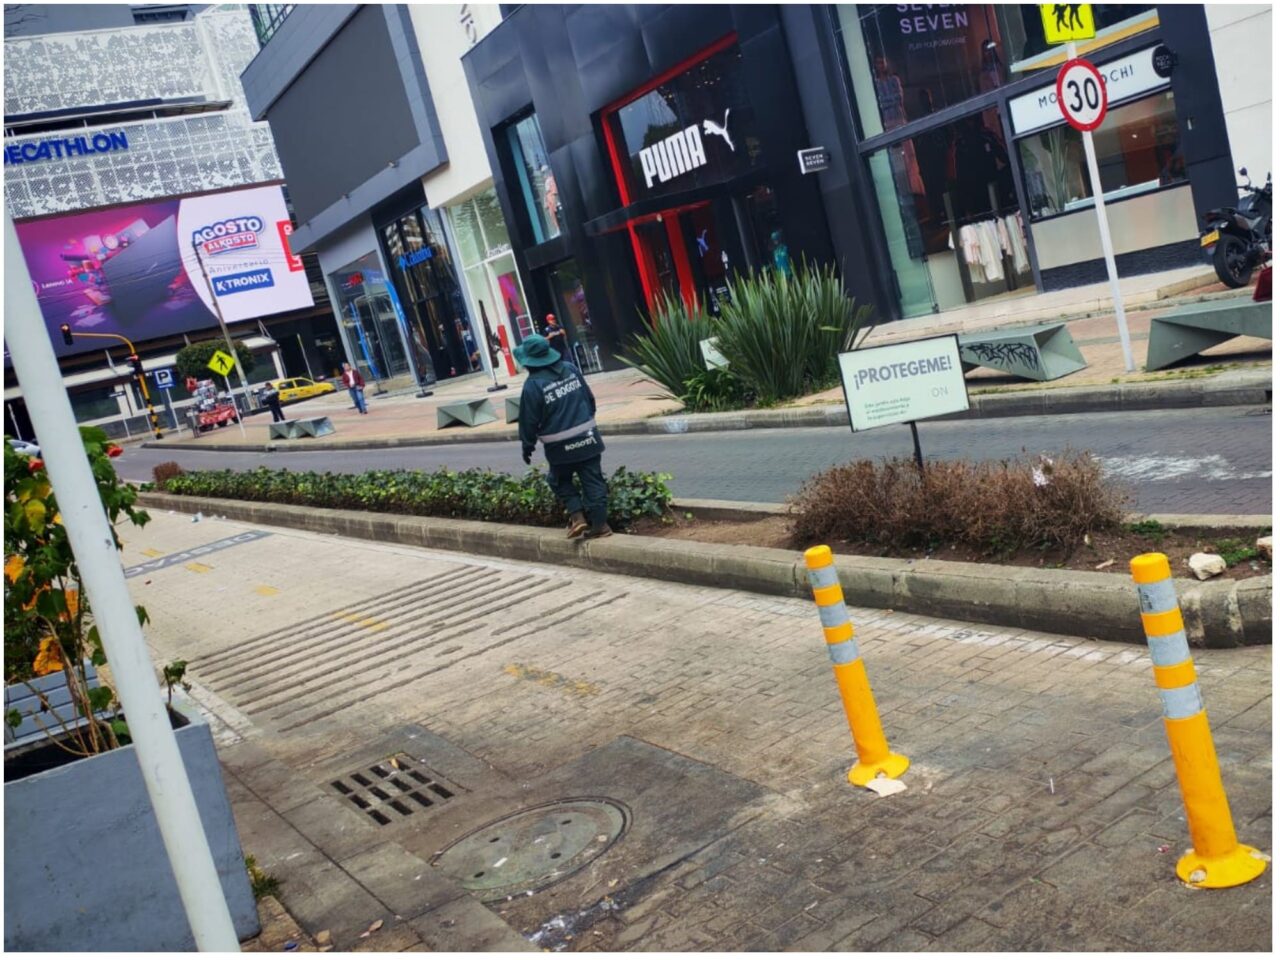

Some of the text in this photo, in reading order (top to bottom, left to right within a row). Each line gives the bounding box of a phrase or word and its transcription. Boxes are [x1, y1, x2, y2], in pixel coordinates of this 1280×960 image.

[900, 12, 968, 34] SEVEN
[1067, 77, 1099, 112] 30
[639, 124, 707, 188] PUMA
[193, 217, 263, 245] AGOSTO
[207, 234, 254, 251] ALKOSTO
[157, 371, 169, 383] P
[854, 355, 952, 390] ¡PROTEGEME!
